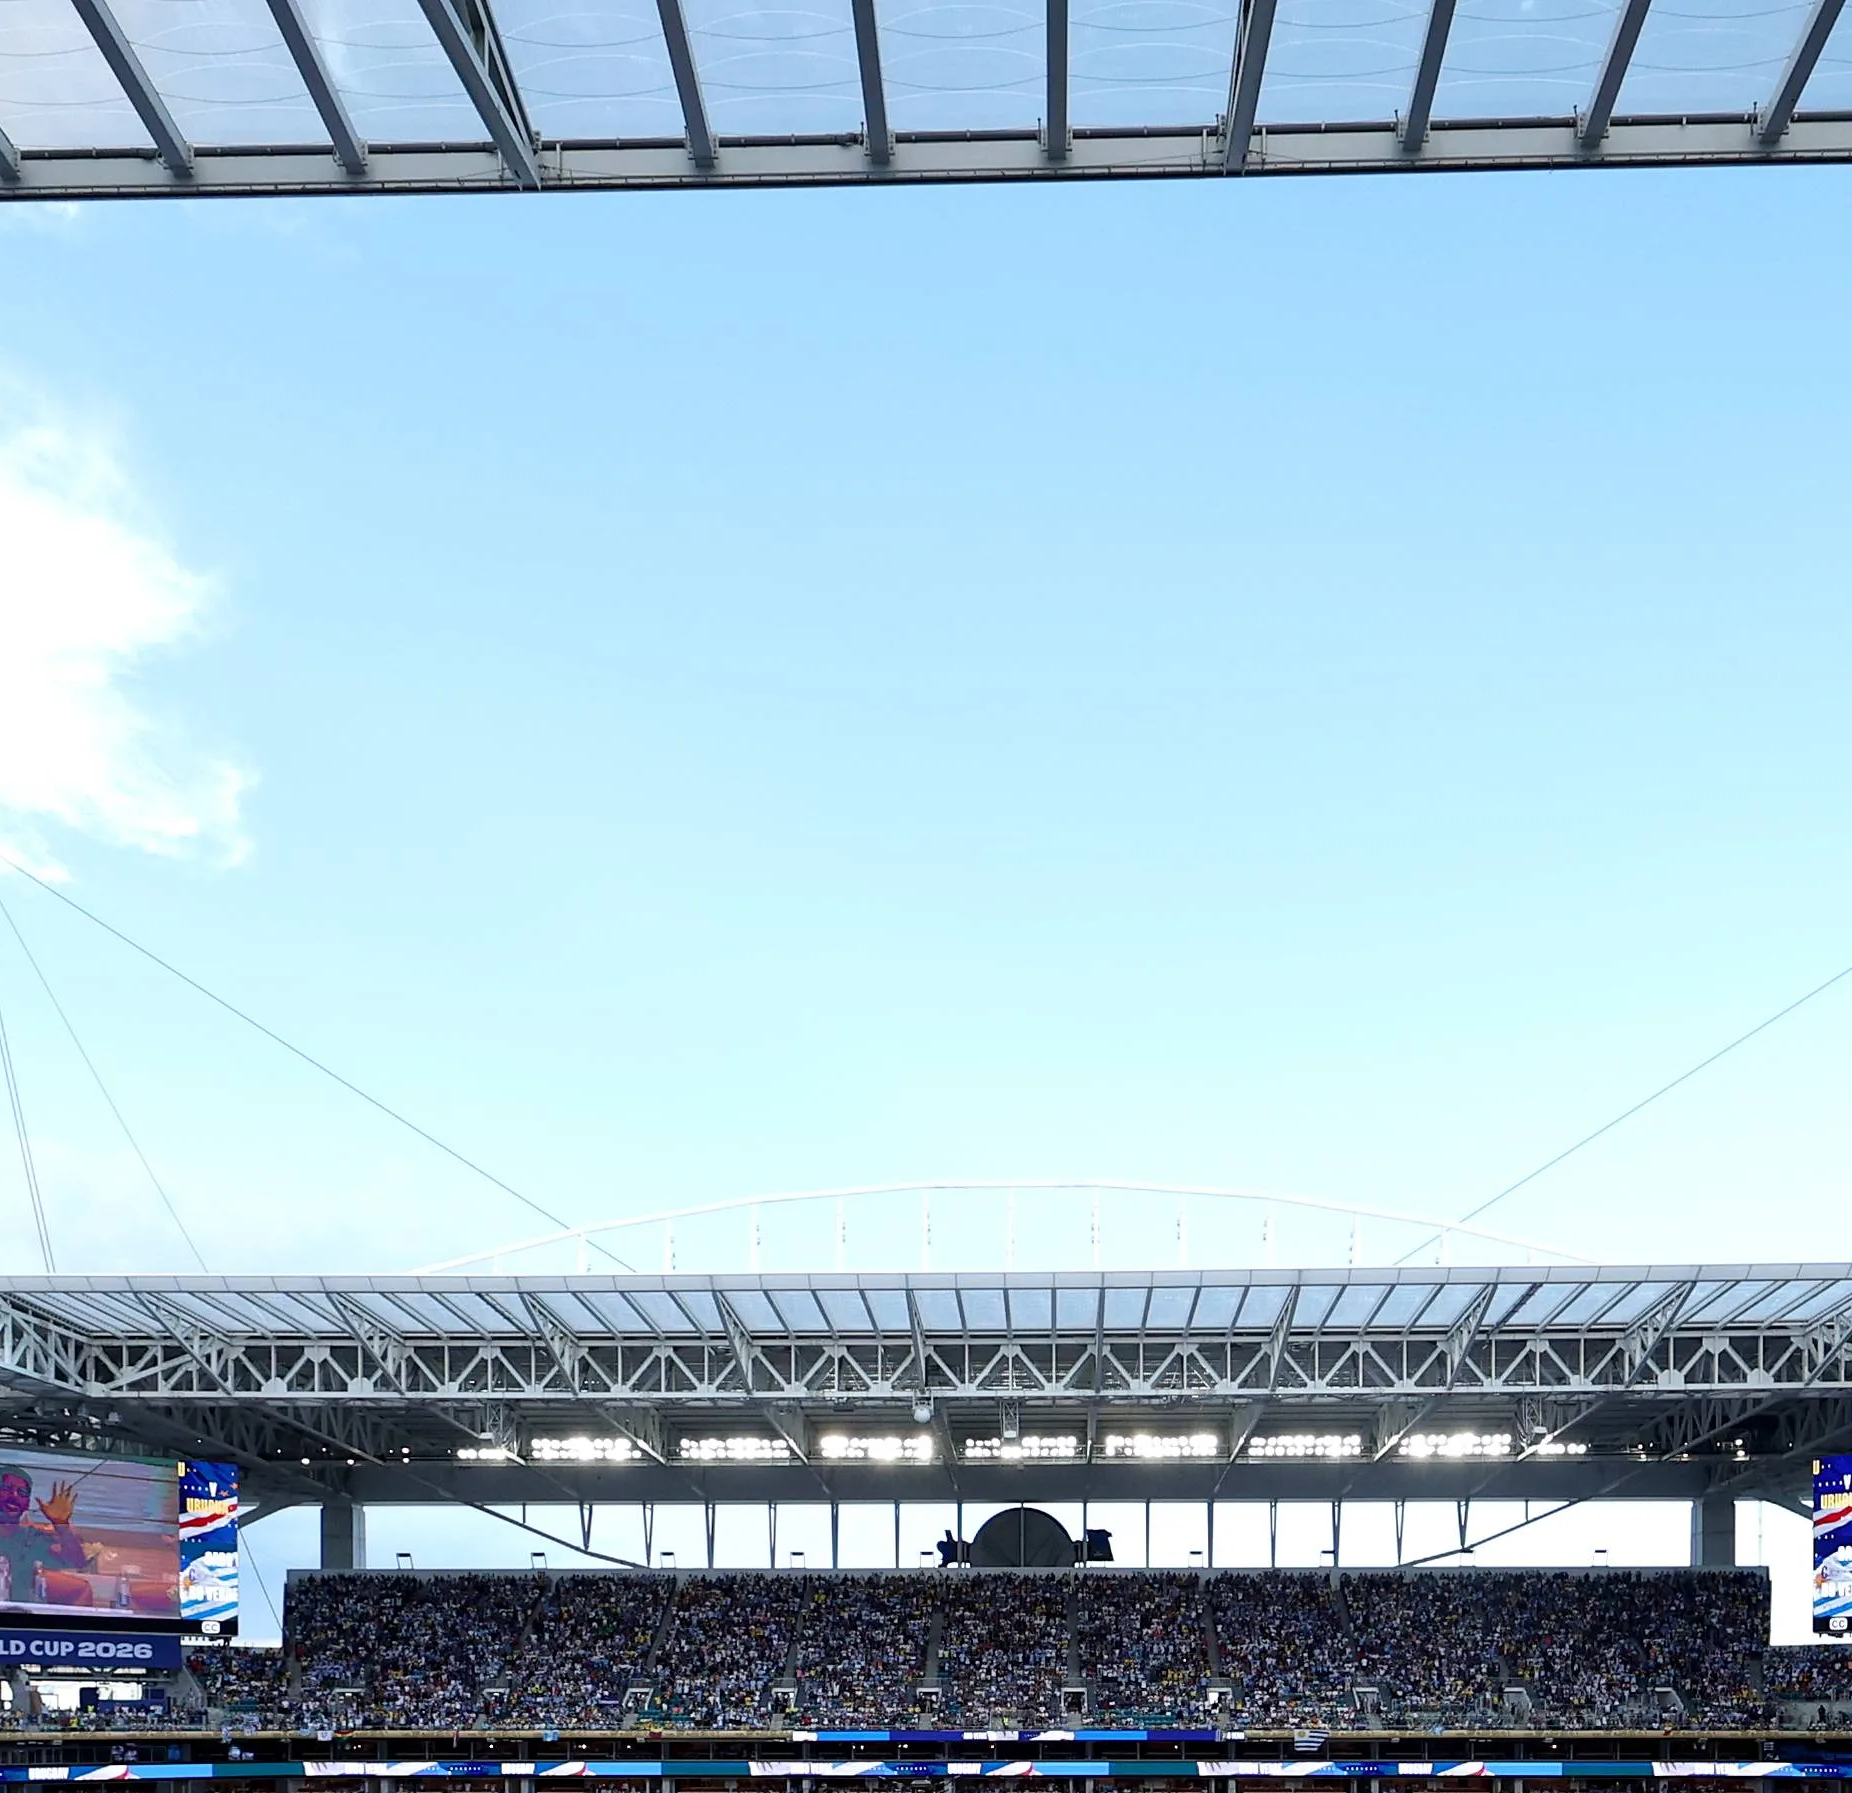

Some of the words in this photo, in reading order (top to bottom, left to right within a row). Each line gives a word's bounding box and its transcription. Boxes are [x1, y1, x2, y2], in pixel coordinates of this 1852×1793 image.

[203, 1622, 218, 1632] CC
[1832, 1619, 1845, 1629] CC
[30, 1639, 73, 1658] CUP
[78, 1641, 153, 1659] 2026
